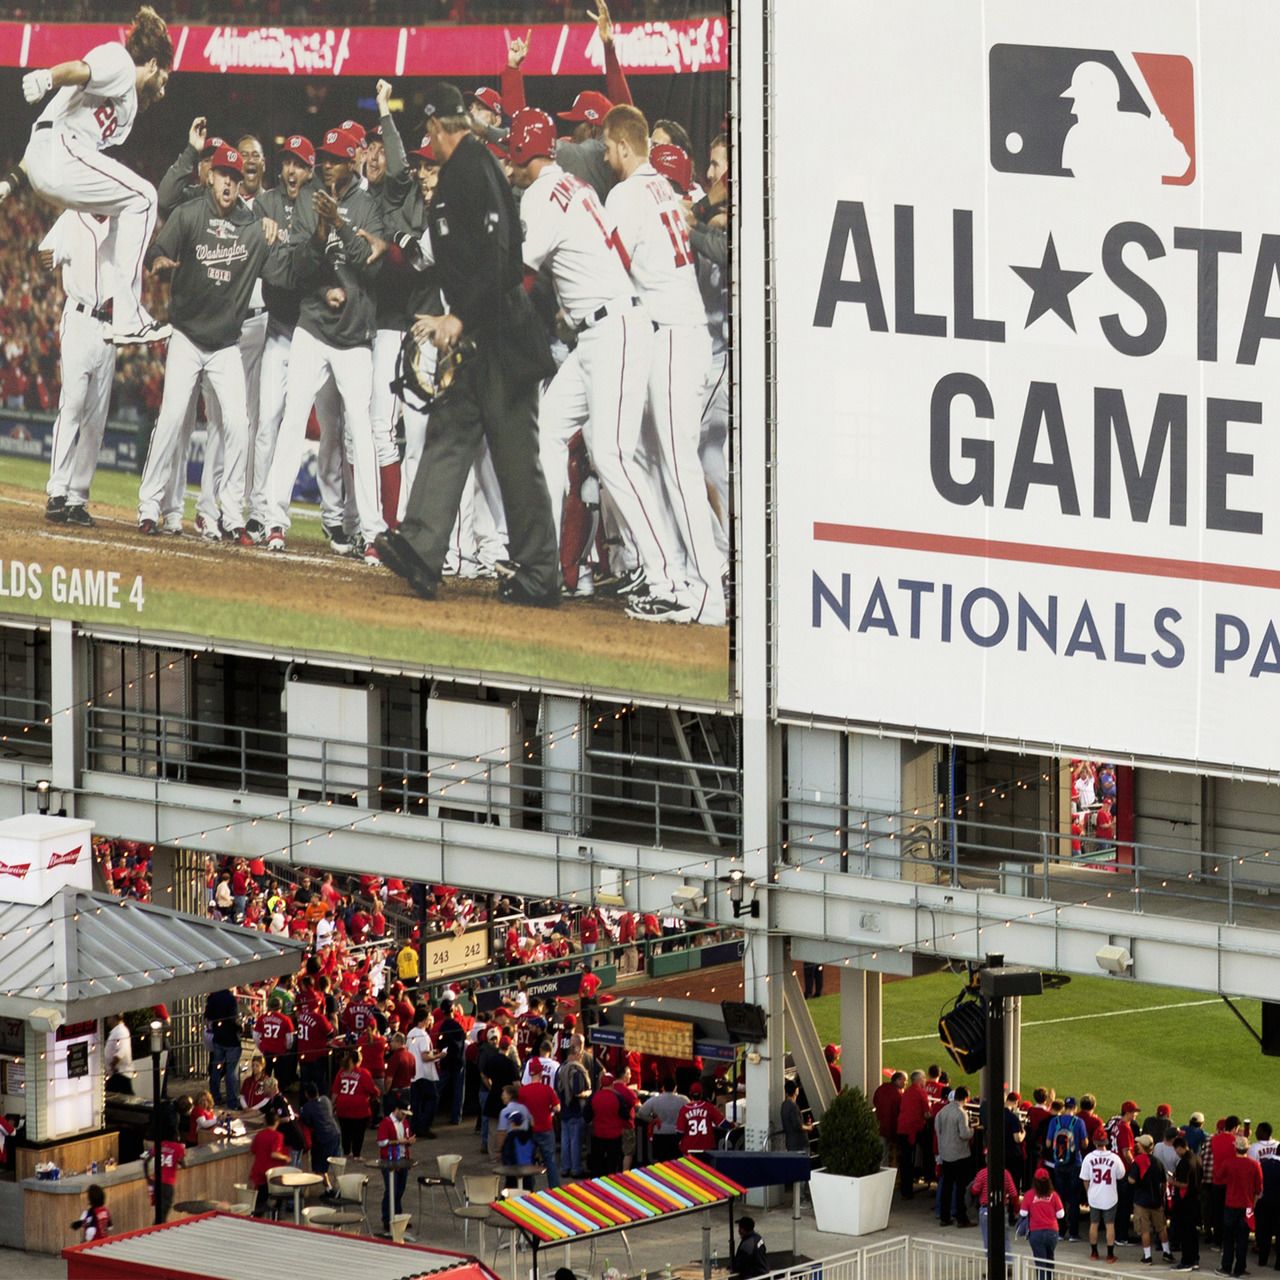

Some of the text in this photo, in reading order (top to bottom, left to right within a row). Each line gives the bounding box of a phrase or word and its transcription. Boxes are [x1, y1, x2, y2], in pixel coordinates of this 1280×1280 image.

[196, 240, 248, 266] Washington
[812, 200, 1005, 344] ALL
[929, 371, 1263, 536] GAME
[0, 559, 145, 612] LDS GAME 4
[811, 569, 1185, 669] NATIONALS
[433, 943, 481, 965] 243 242
[355, 1014, 365, 1029] 6
[264, 1023, 281, 1039] 37
[297, 1024, 309, 1041] 31
[340, 1079, 359, 1095] 37
[684, 1108, 708, 1120] HARPER
[688, 1122, 708, 1136] 34
[1090, 1156, 1114, 1168] HARPER
[1092, 1168, 1112, 1184] 34
